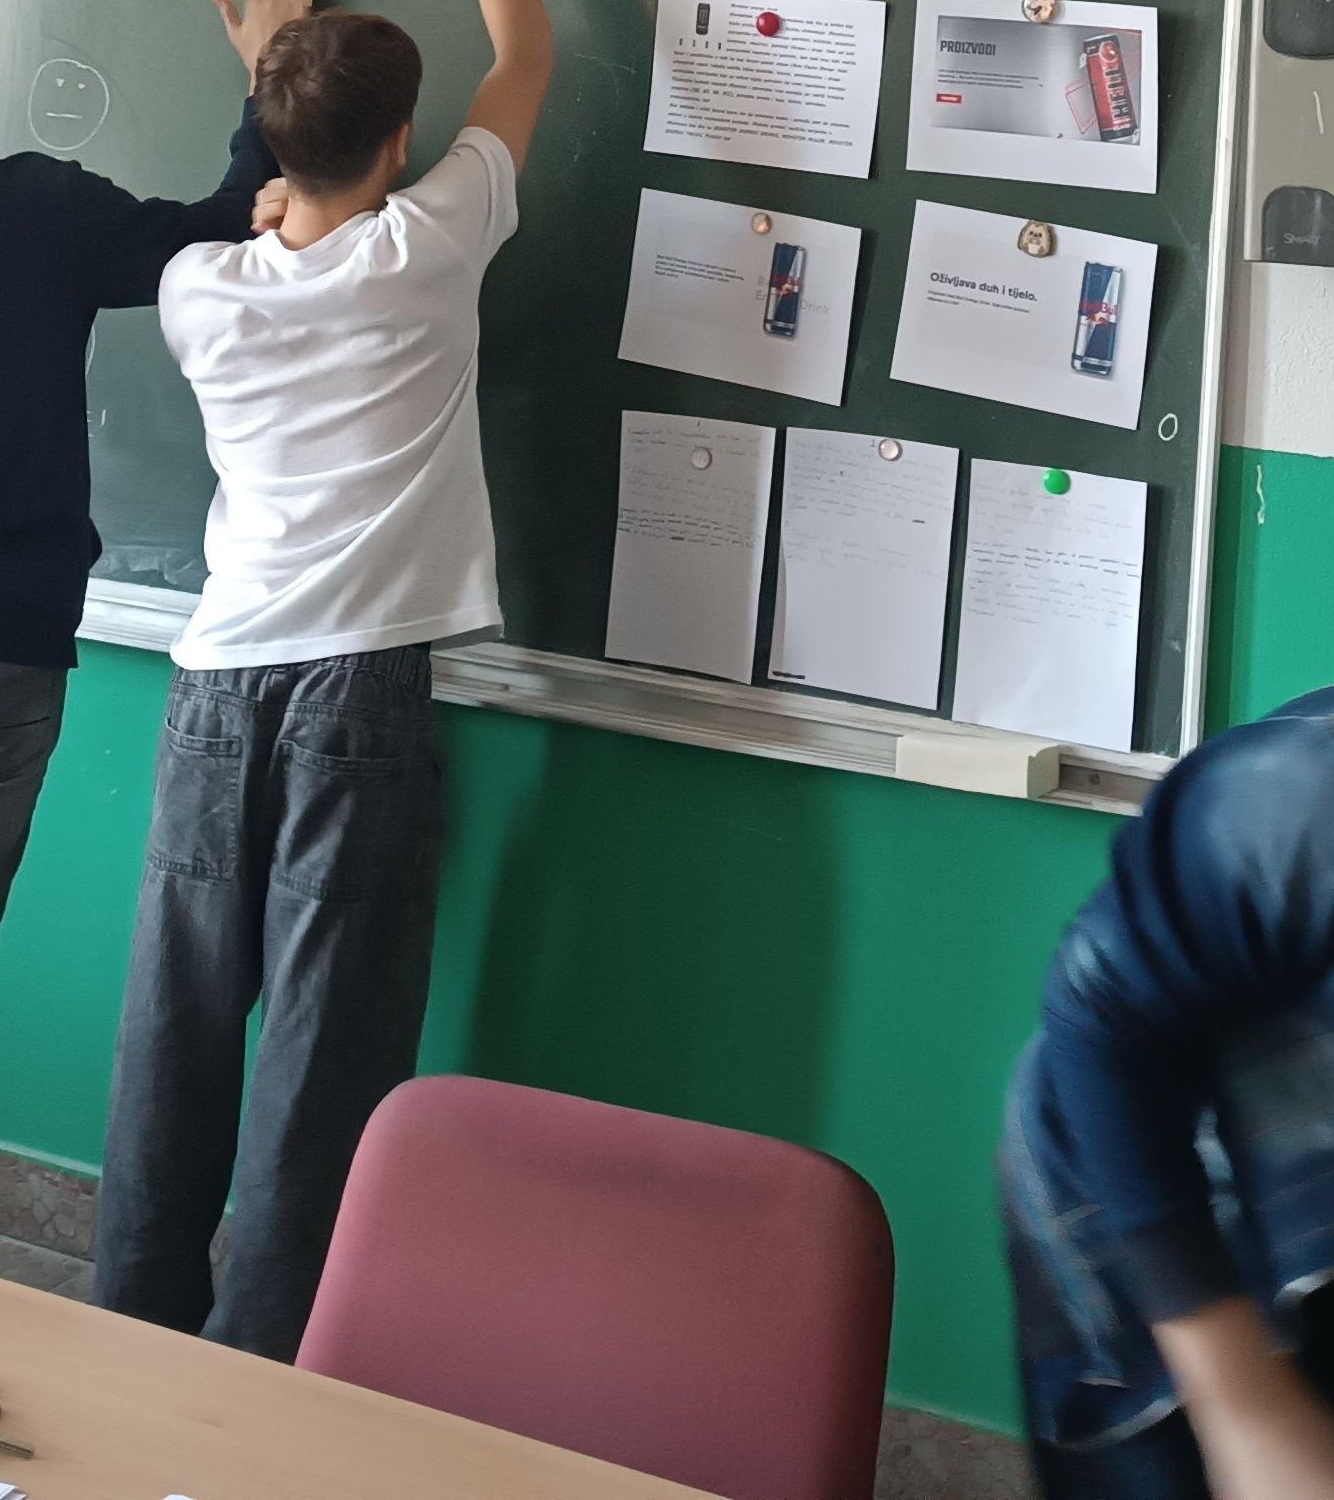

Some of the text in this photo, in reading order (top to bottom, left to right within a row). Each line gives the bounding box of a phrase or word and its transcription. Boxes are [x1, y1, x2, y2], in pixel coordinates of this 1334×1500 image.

[940, 40, 996, 56] PROIZVODI
[1283, 232, 1322, 245] SMART
[930, 272, 976, 290] Oživljava
[979, 282, 999, 294] duh
[1008, 287, 1038, 301] tijelo.
